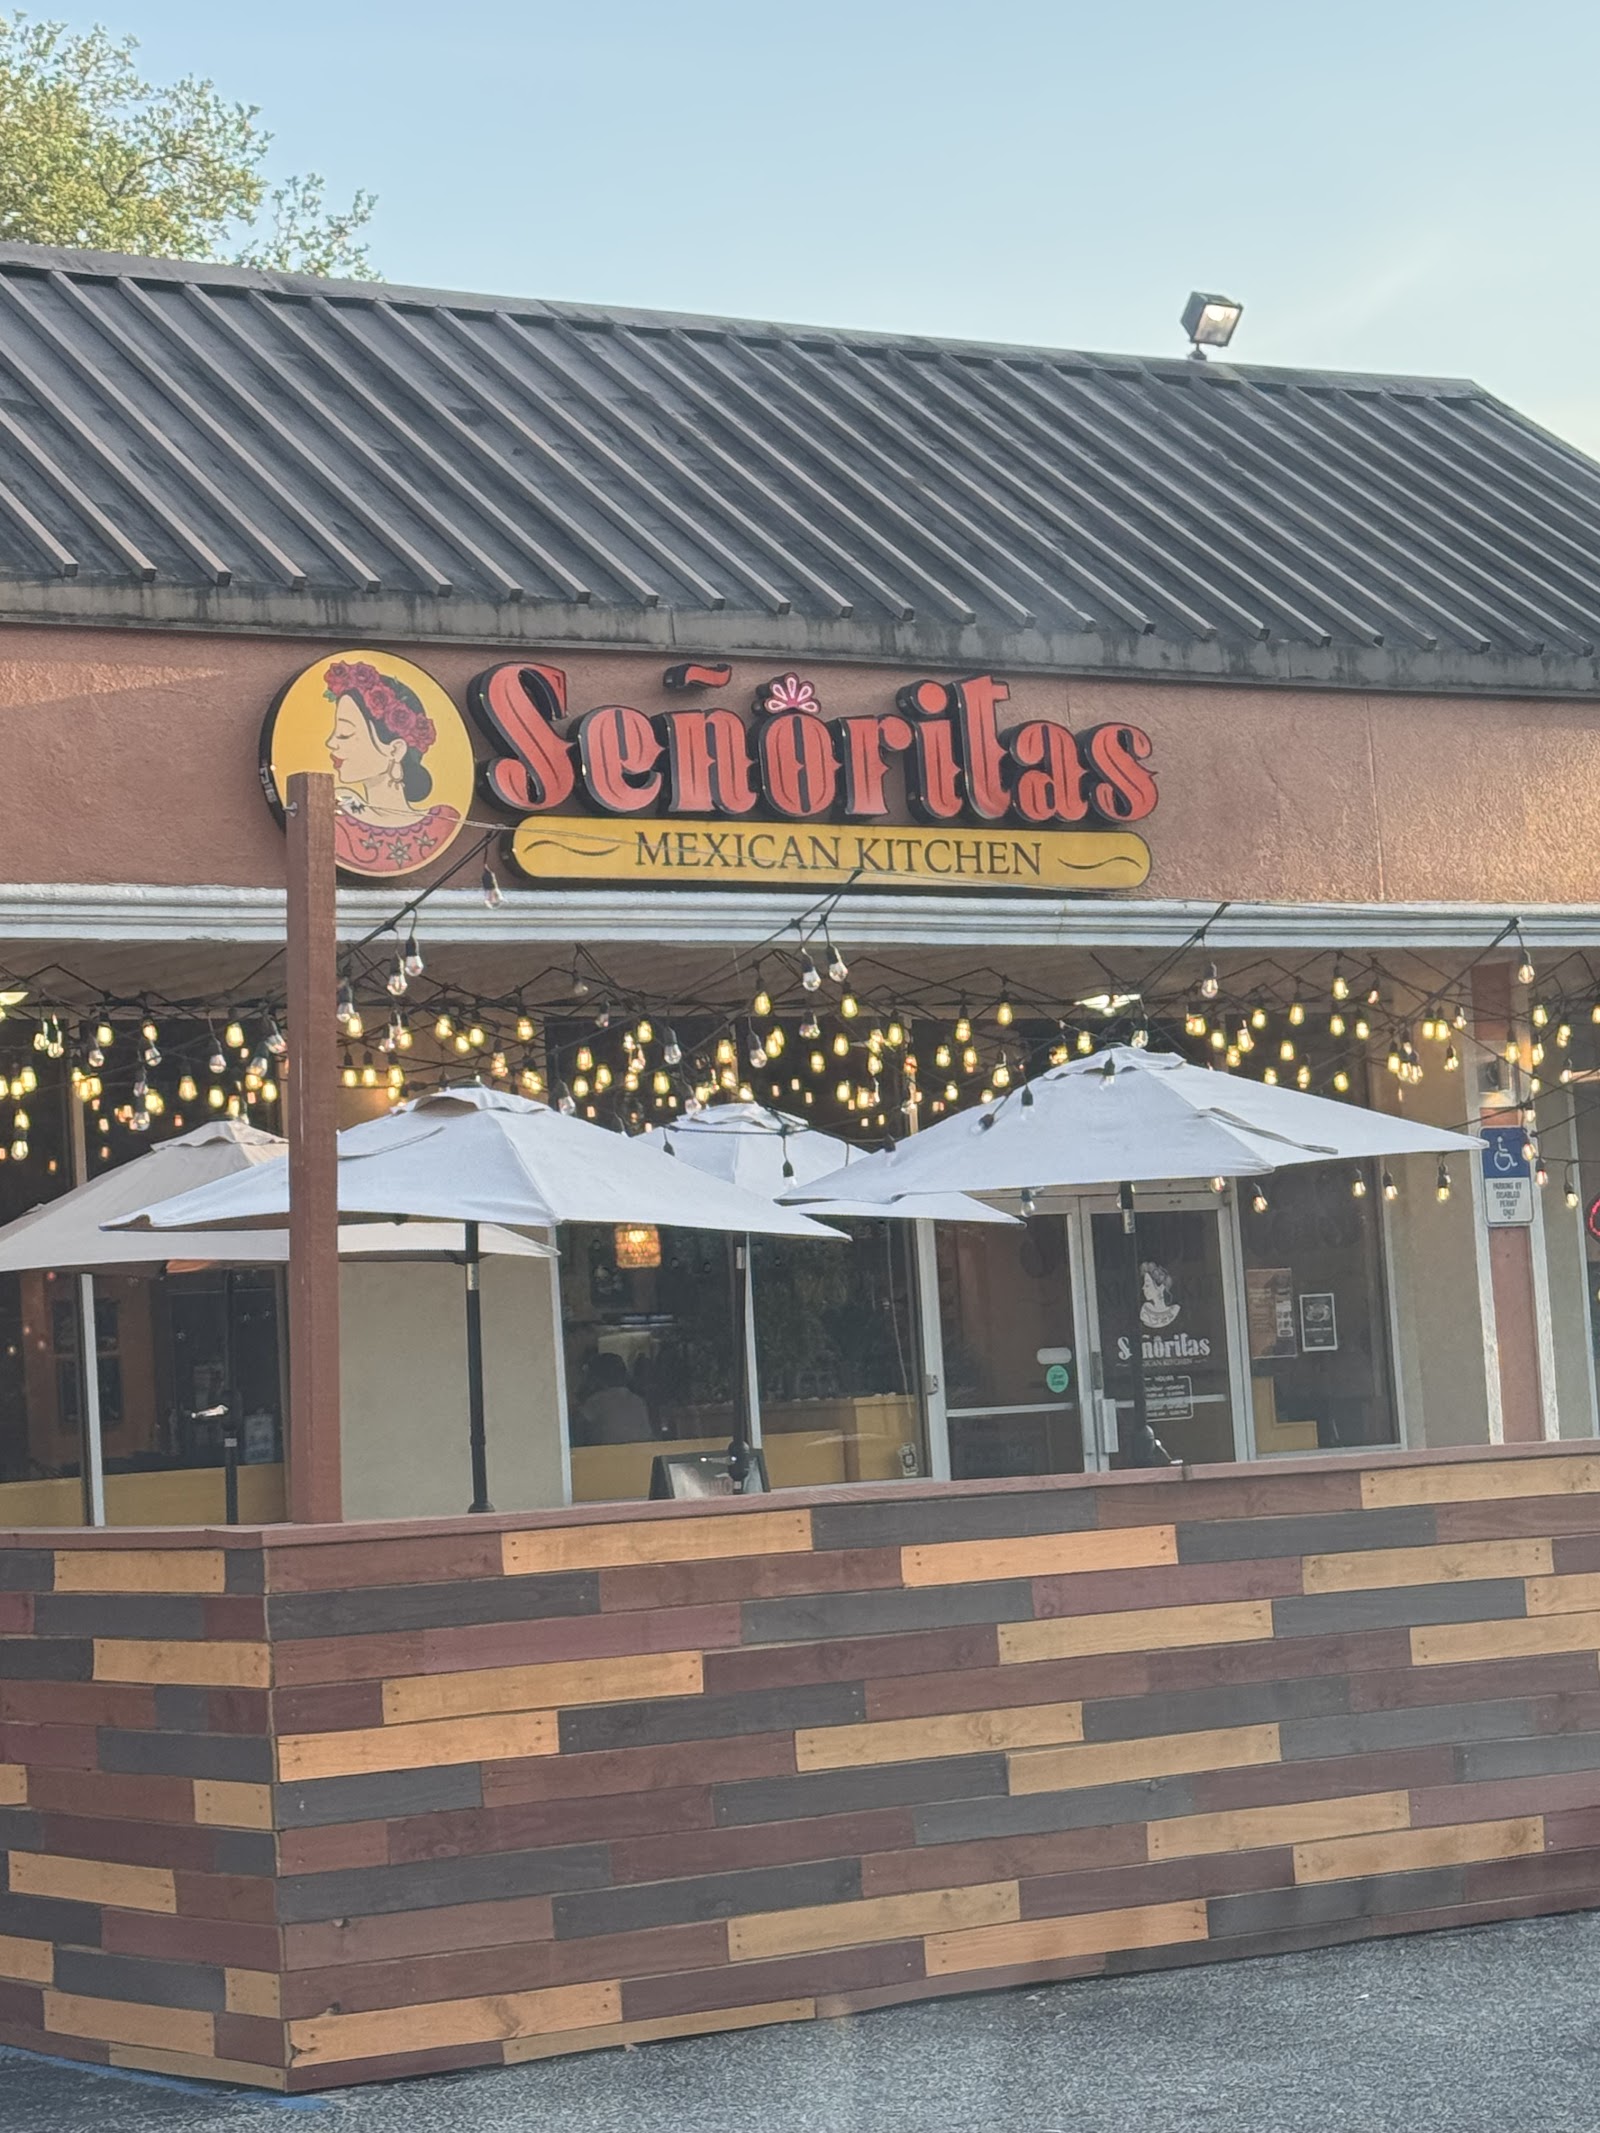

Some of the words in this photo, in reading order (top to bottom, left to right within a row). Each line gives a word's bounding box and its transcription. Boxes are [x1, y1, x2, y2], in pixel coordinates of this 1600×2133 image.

[470, 661, 1159, 822] Señoritas
[635, 831, 841, 869] MEXICAN
[856, 837, 1042, 875] KITCHEN
[1492, 1182, 1514, 1190] PARKING
[1495, 1191, 1520, 1199] DISABLED
[1499, 1199, 1517, 1207] PERMIT
[1502, 1208, 1515, 1217] ONLY
[1117, 1333, 1210, 1360] Sñoritas
